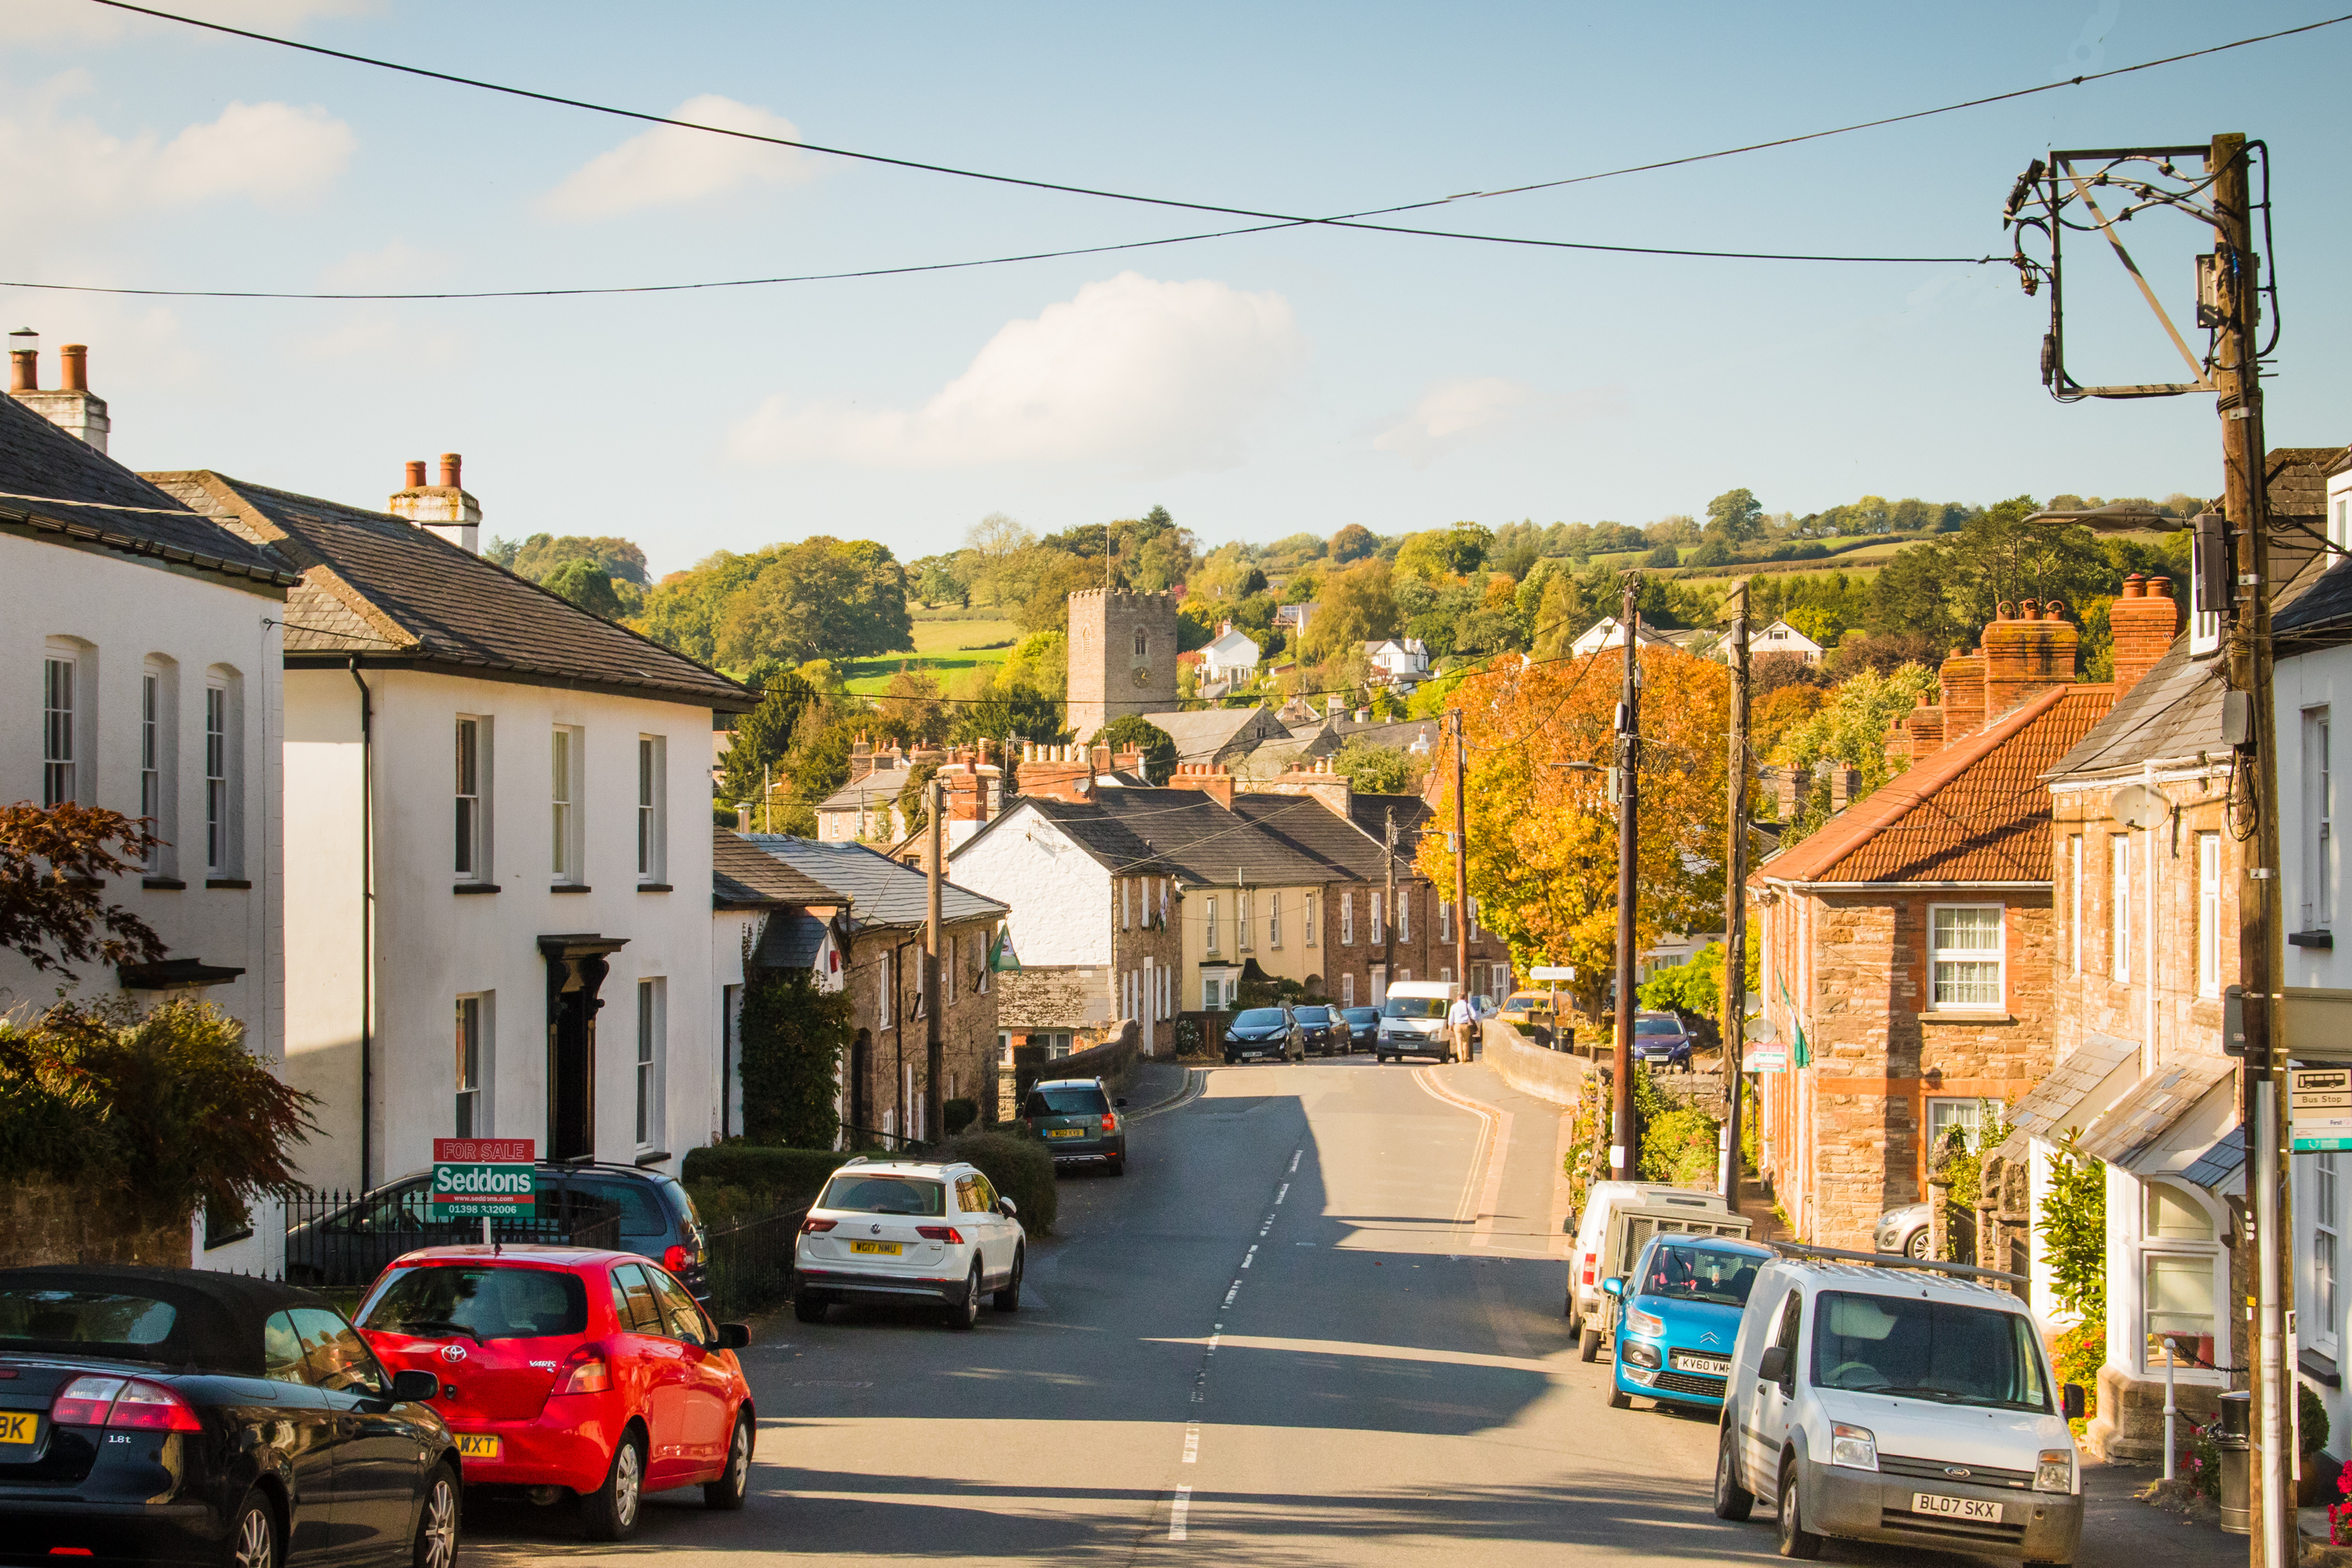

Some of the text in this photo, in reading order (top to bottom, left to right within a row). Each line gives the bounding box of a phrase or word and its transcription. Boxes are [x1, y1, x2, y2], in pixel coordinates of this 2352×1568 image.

[1755, 1054, 1784, 1063] Seddons
[443, 1142, 524, 1160] FOR SALE
[437, 1167, 532, 1192] Seddons
[448, 1205, 517, 1214] 01398 332006
[855, 1242, 896, 1254] WG17 NMU
[1682, 1358, 1709, 1370] KV60
[460, 1437, 495, 1454] WXT
[1920, 1495, 1995, 1518] BL07 SKX
